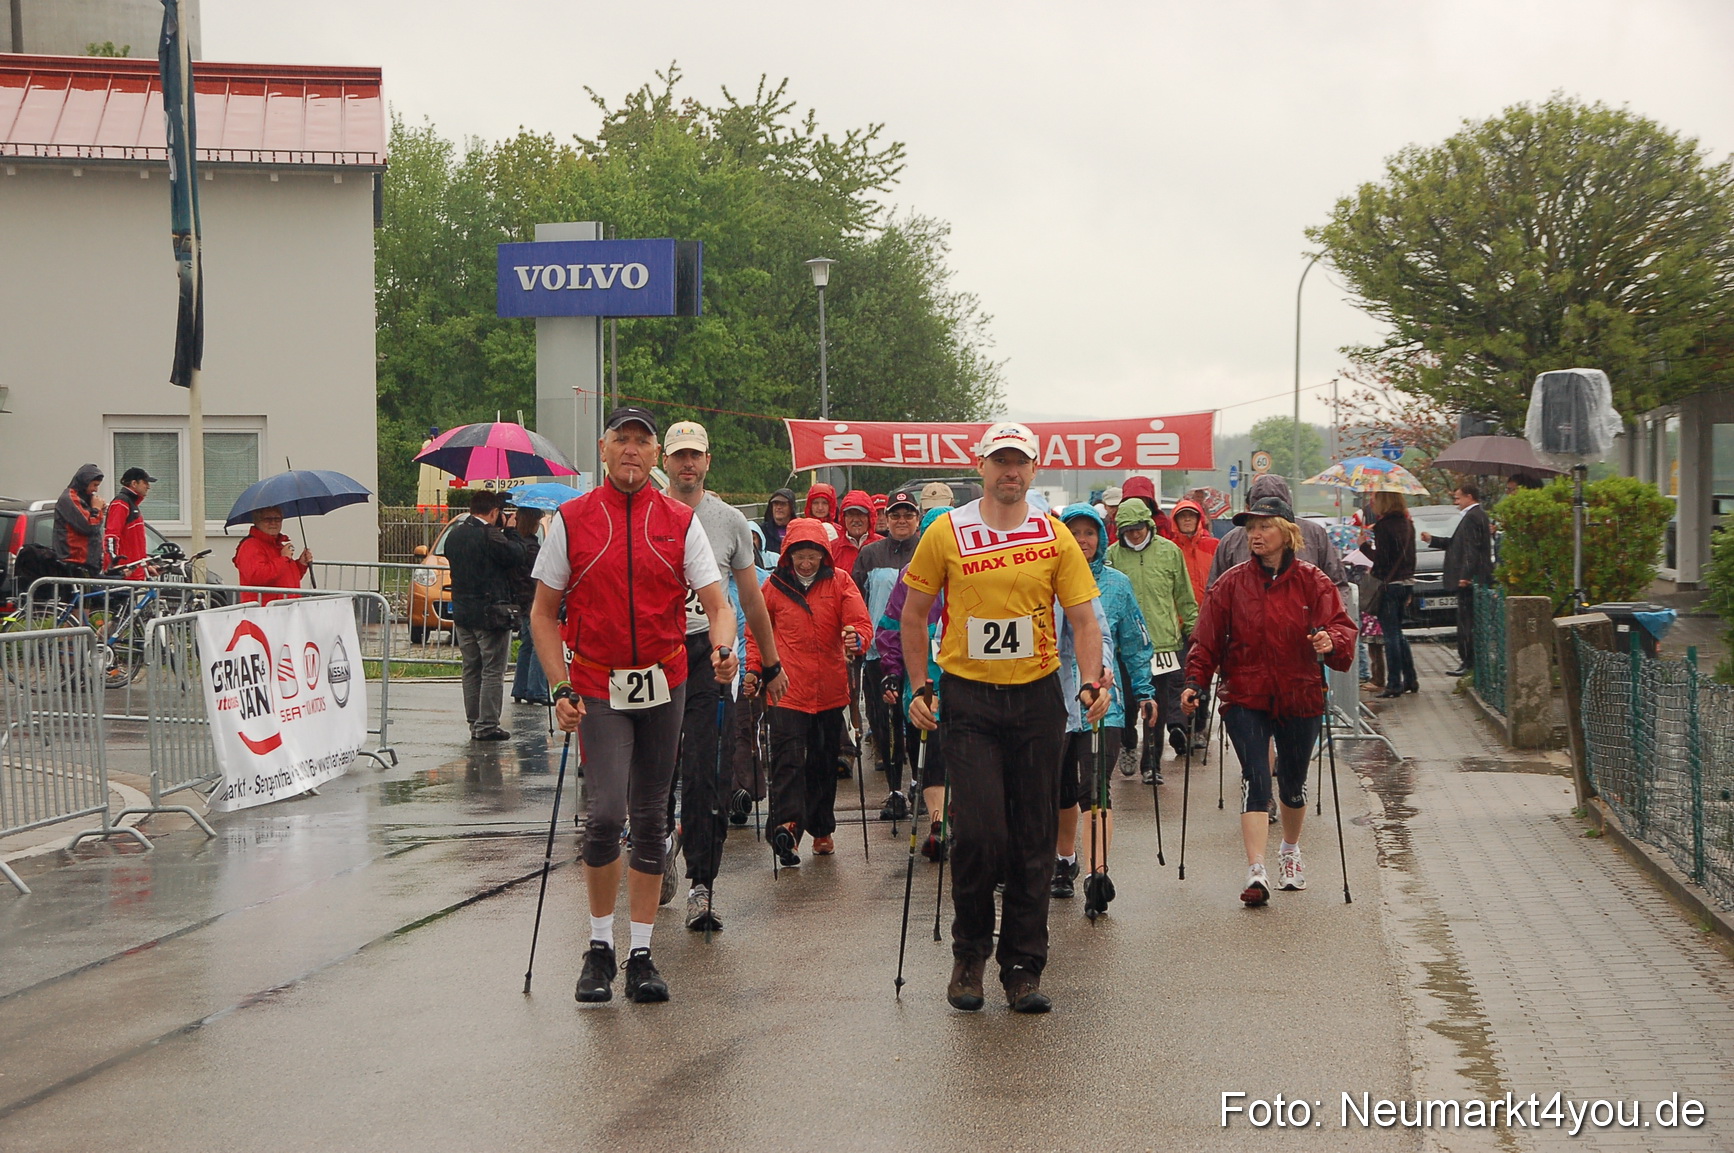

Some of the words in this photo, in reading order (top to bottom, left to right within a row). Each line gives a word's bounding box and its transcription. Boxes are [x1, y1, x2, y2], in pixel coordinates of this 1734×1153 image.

[513, 262, 650, 291] VOLVO
[1256, 457, 1268, 467] 60
[962, 556, 1008, 576] MAX
[1012, 546, 1059, 566] BÖGL
[982, 621, 1020, 655] 24
[1156, 651, 1173, 669] 40
[627, 669, 655, 704] 21
